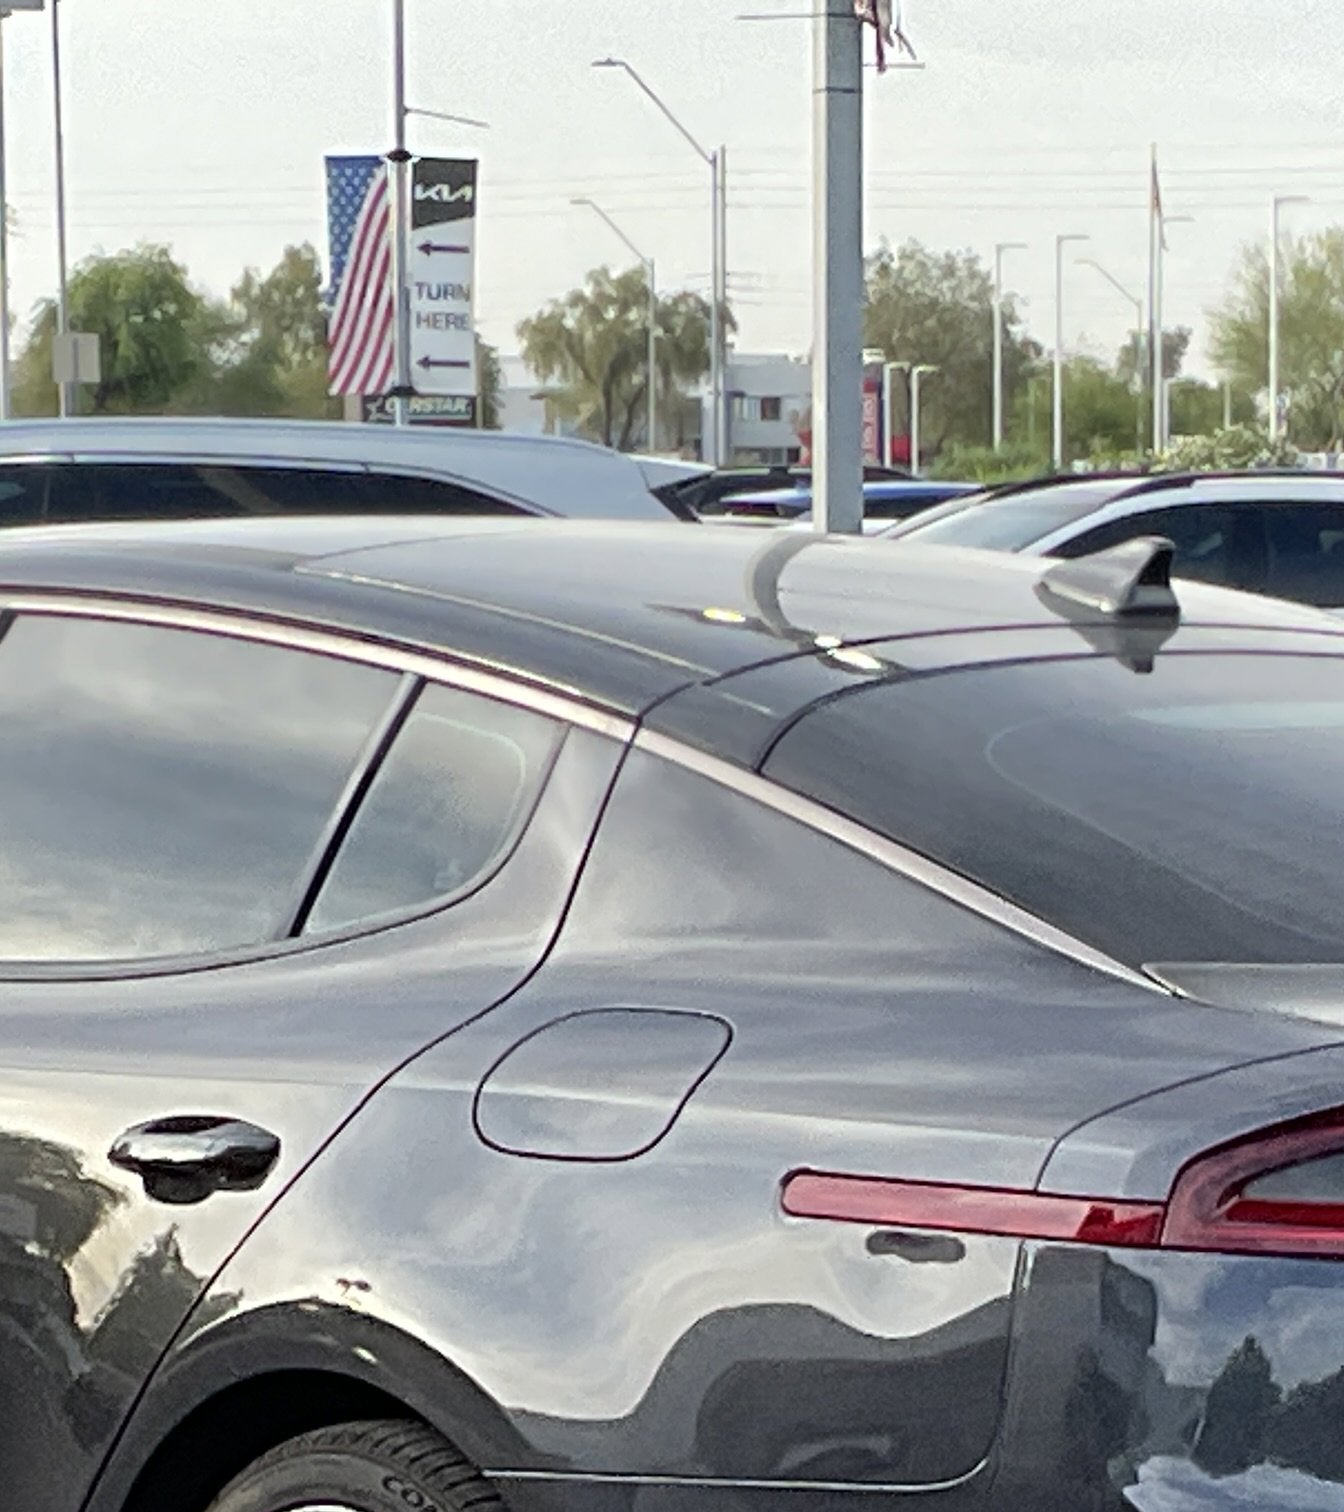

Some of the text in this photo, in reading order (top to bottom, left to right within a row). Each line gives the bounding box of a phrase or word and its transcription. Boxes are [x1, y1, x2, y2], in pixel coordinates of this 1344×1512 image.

[413, 183, 473, 202] KIA
[414, 281, 471, 302] TURN
[414, 311, 470, 330] HERE
